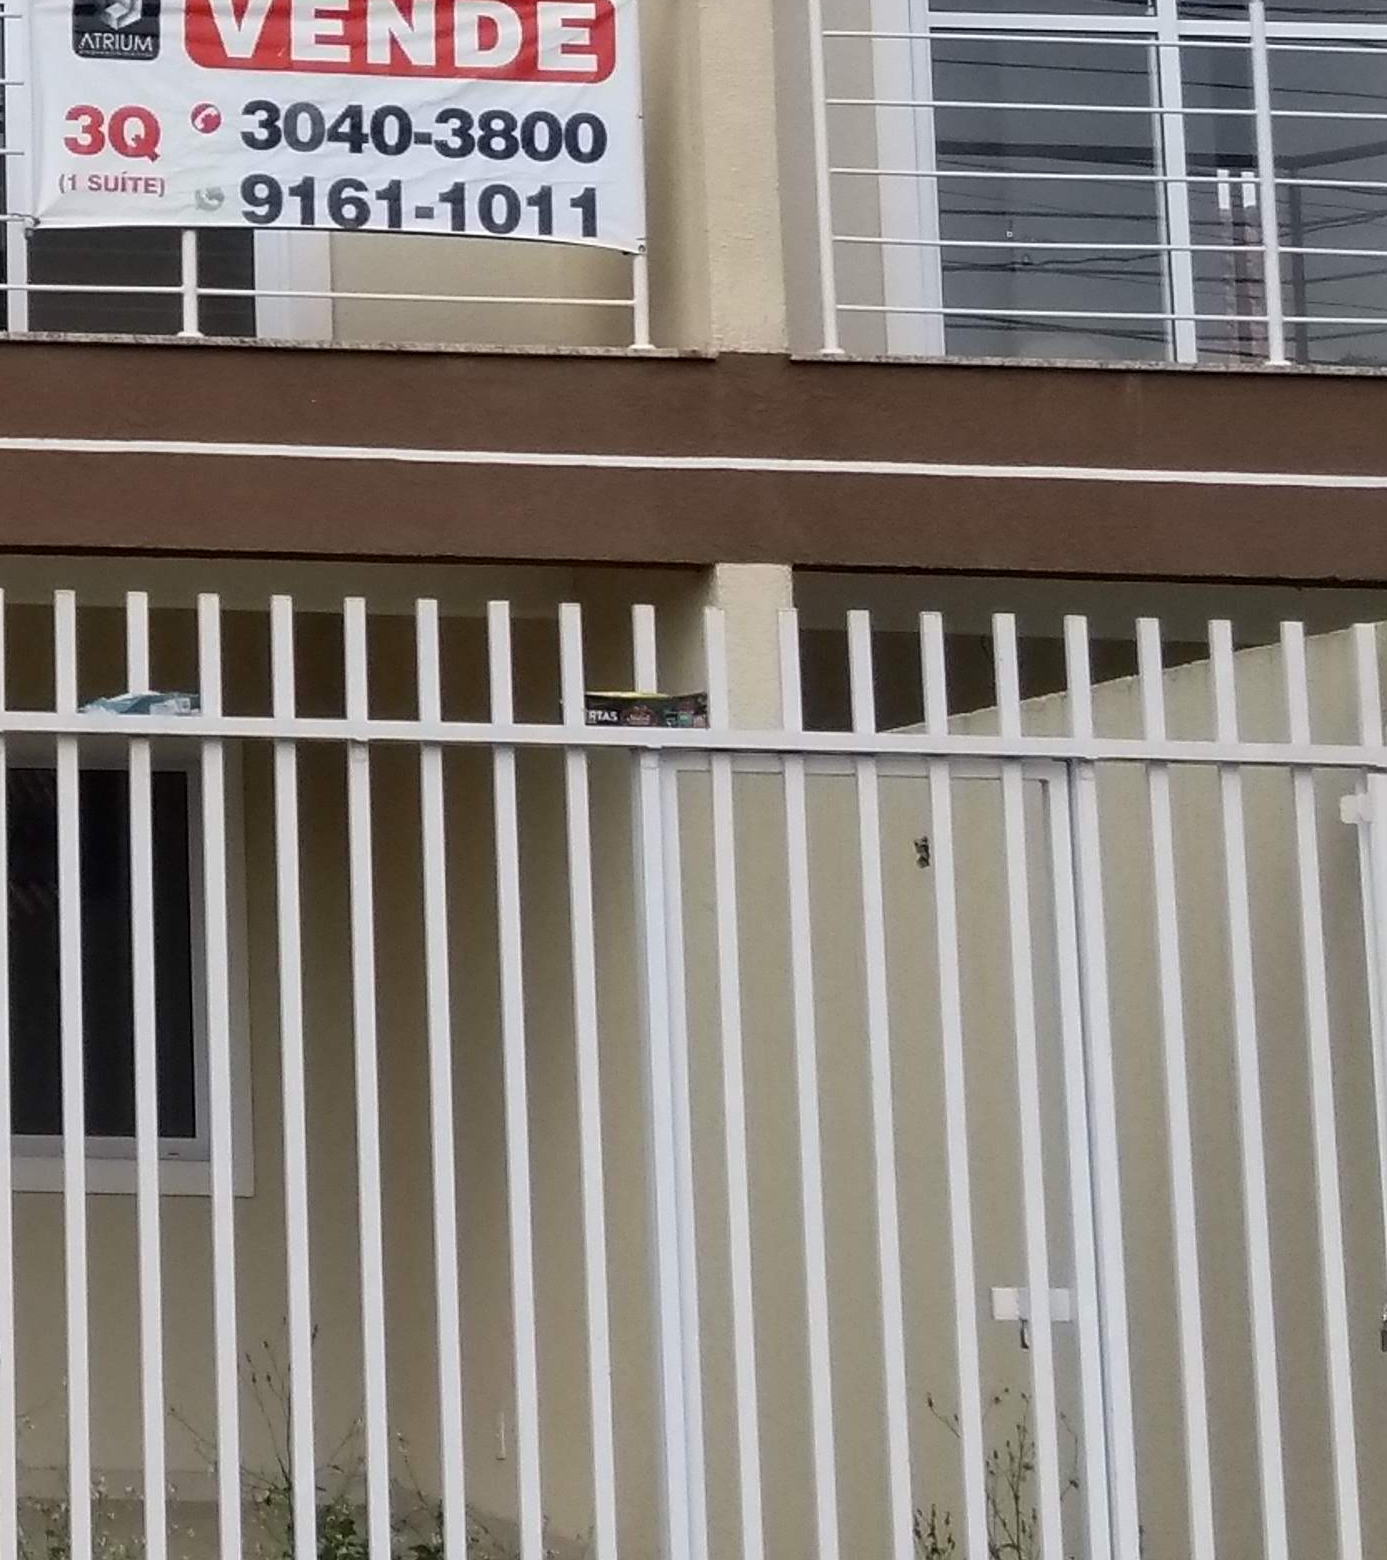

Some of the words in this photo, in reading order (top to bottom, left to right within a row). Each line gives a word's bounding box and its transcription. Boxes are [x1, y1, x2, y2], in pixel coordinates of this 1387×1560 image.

[77, 32, 153, 52] ATRIUM
[63, 104, 162, 162] 3Q
[240, 99, 608, 165] 3040-3800
[58, 173, 77, 194] (1
[87, 171, 166, 198] SUÍTE)
[240, 173, 598, 238] 9161-1011
